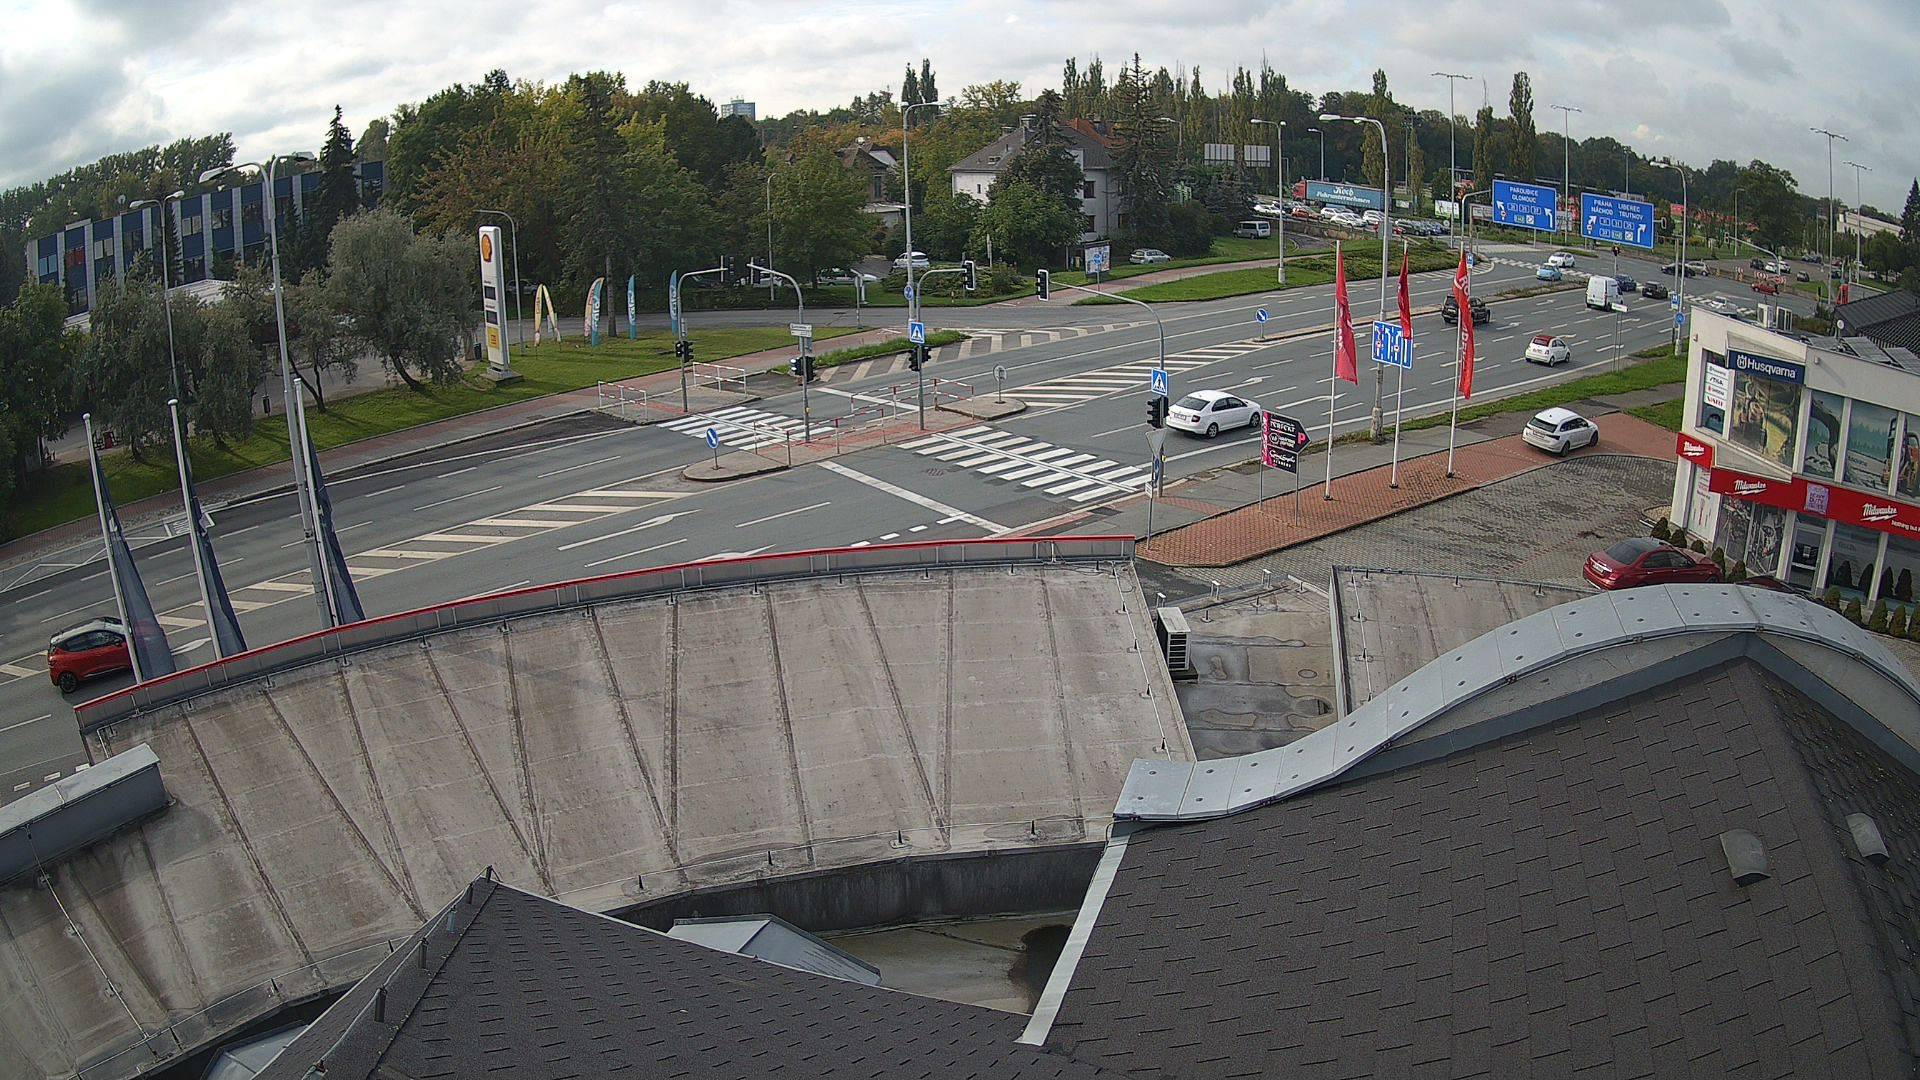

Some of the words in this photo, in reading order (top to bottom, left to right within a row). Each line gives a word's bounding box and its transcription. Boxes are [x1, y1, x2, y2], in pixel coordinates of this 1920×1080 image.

[1747, 358, 1797, 379] Husqvarna
[1734, 479, 1767, 491] Milwaukee
[1862, 503, 1898, 517] Milwaukee
